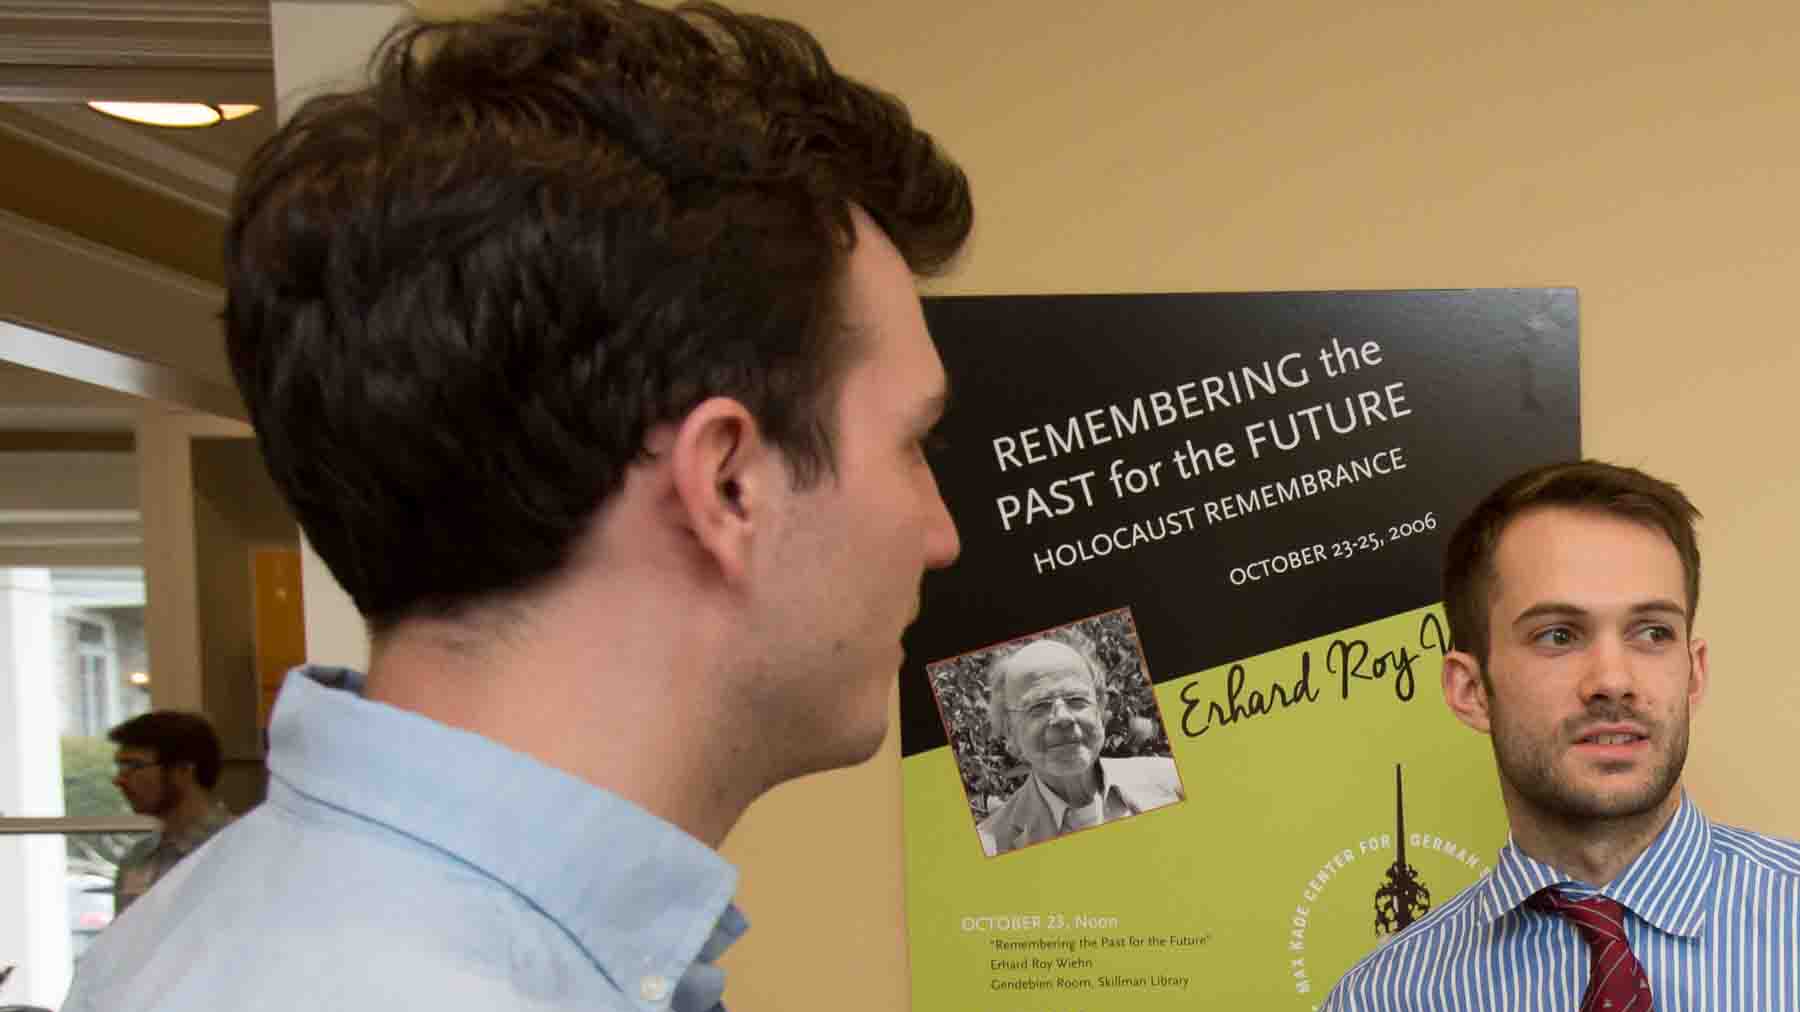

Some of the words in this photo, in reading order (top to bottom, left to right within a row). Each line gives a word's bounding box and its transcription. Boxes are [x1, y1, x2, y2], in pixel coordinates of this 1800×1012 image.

[993, 352, 1310, 472] REMEMBERING
[1319, 338, 1383, 378] the
[996, 471, 1096, 531] PAST
[1109, 458, 1163, 498] for
[1173, 439, 1236, 481] the
[1245, 382, 1412, 459] FUTURE
[1033, 507, 1196, 574] HOLOCAUST
[1204, 448, 1407, 526] REMEMBRANCE
[1229, 543, 1328, 585] OCTOBER
[1331, 532, 1385, 559] 23-25,
[1389, 511, 1438, 541] 2006
[1179, 651, 1320, 737] Erhard
[1326, 639, 1420, 701] Roy
[1359, 834, 1391, 856] FOR
[1409, 833, 1480, 868] GERMAN
[1303, 849, 1356, 902] CENTER
[960, 916, 1041, 932] OCTOBER
[1074, 915, 1120, 929] Noon
[1079, 937, 1098, 949] the
[1101, 936, 1126, 948] Past
[1129, 935, 1145, 948] for
[1148, 935, 1167, 947] the
[1289, 905, 1311, 951] KADE
[990, 959, 1028, 971] Erhard
[1031, 959, 1053, 973] Roy
[1056, 958, 1093, 969] Wiehn
[1098, 975, 1147, 987] Skillman
[1151, 975, 1189, 989] Library
[1292, 958, 1311, 993] MAX
